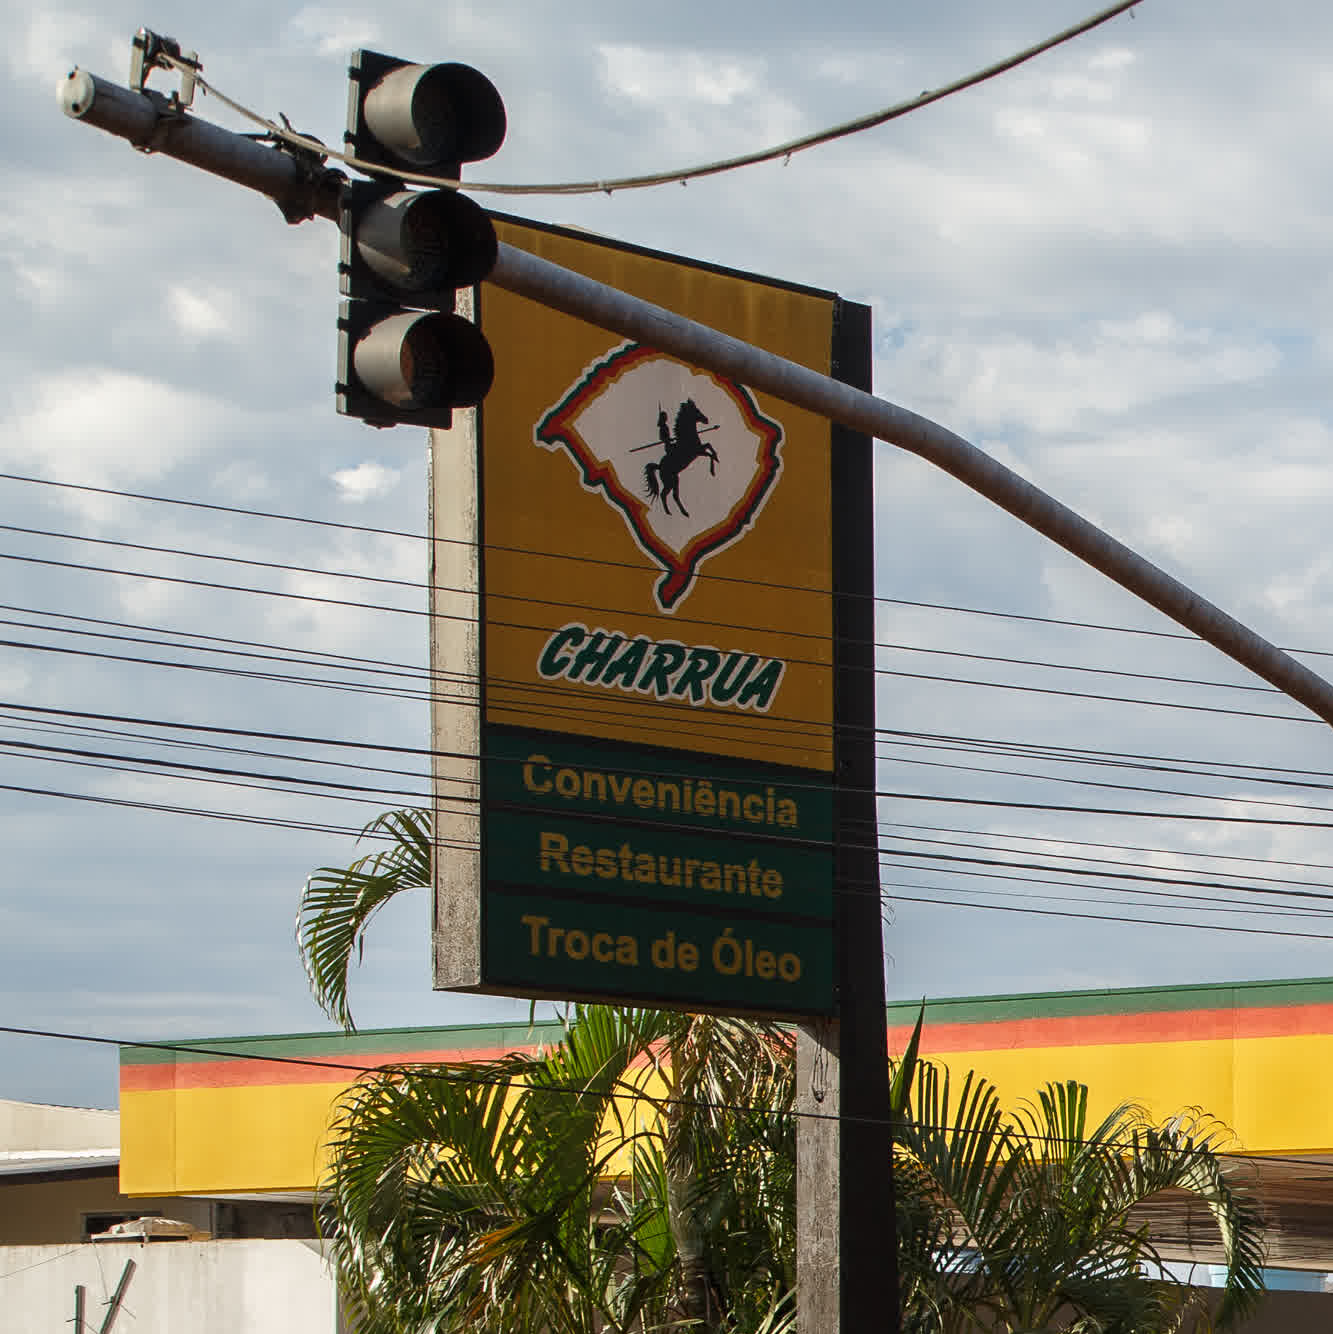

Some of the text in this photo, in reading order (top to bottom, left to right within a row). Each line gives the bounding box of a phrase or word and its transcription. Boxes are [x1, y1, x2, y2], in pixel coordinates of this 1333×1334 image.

[539, 623, 785, 712] CHARRUA
[524, 754, 799, 827] Conveniência
[540, 833, 784, 898] Restaurante
[522, 916, 802, 983] Troca de Óleo
